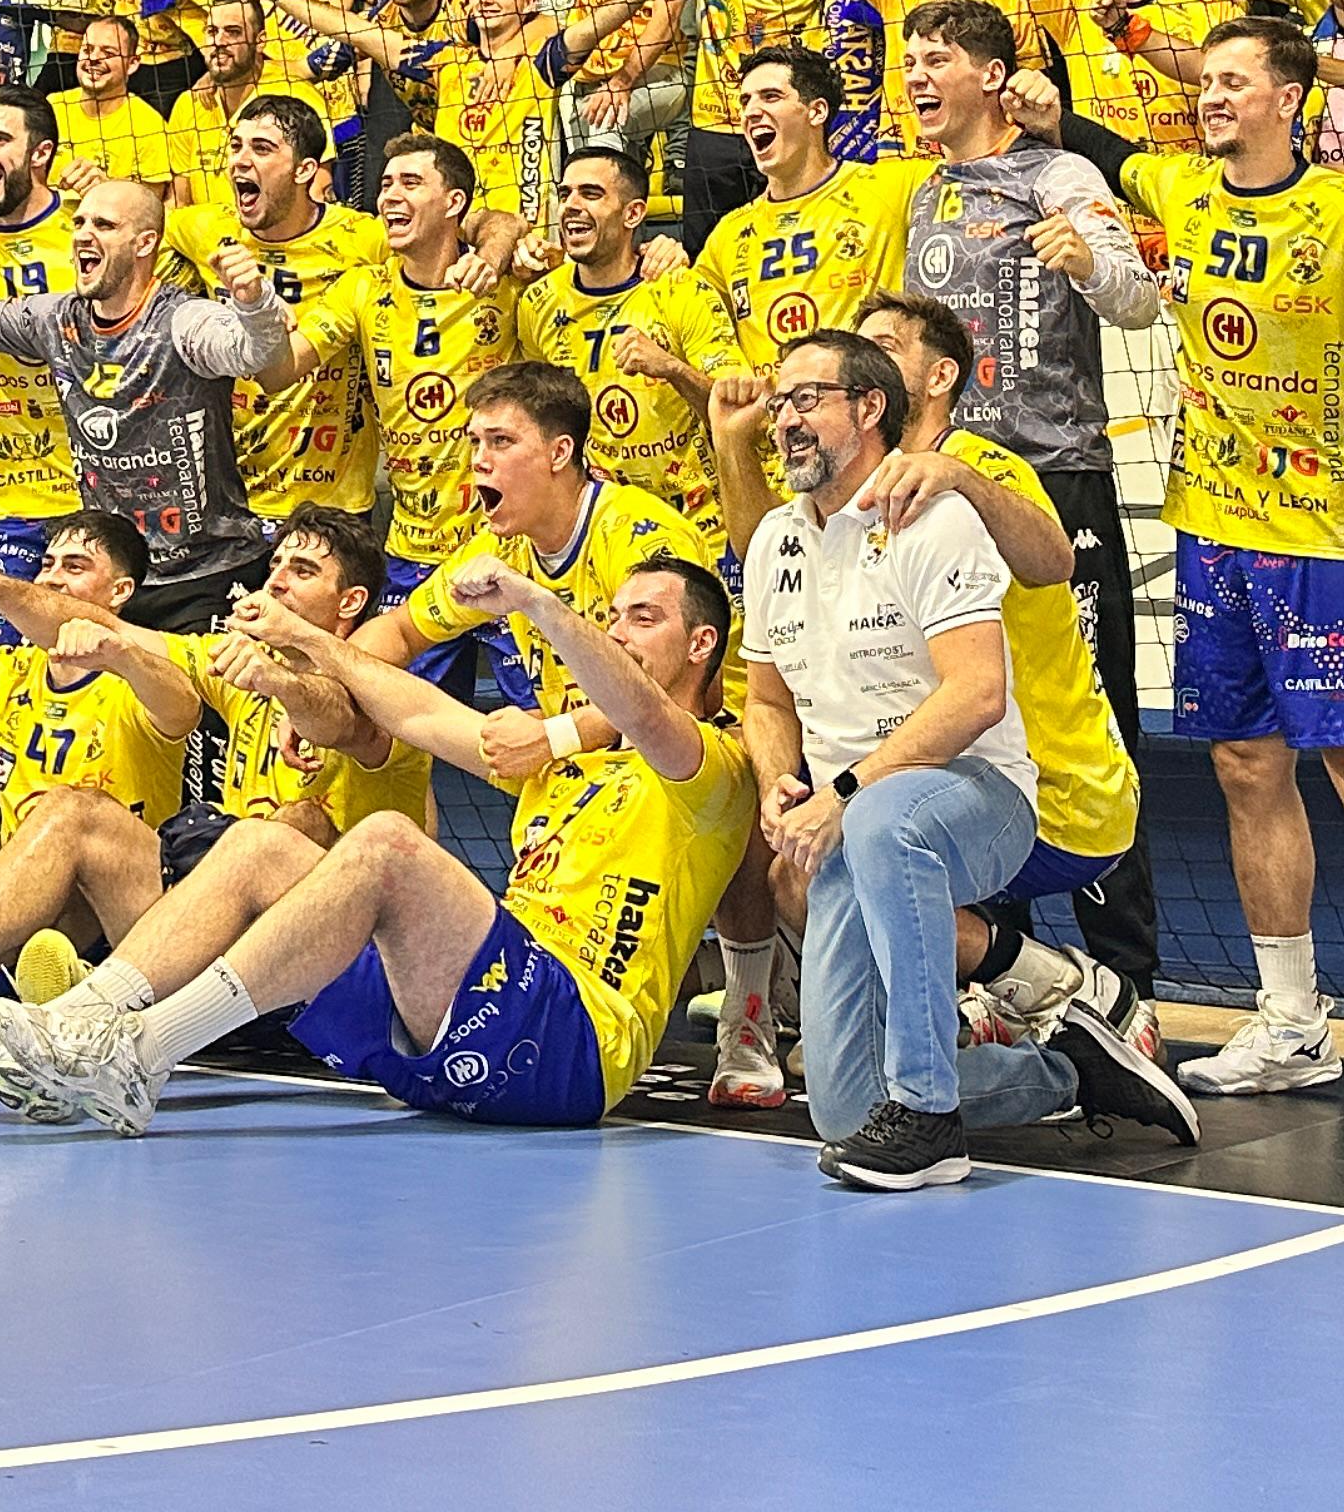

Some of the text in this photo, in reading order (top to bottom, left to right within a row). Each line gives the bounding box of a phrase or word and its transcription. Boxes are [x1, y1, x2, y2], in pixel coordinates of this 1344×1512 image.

[1089, 99, 1139, 123] tubos
[759, 230, 820, 282] 25
[1204, 228, 1268, 284] 50
[1018, 255, 1048, 371] haizea
[1272, 292, 1334, 315] GSK
[413, 317, 441, 358] 6
[997, 256, 1021, 393] tecnoaranda
[1221, 370, 1319, 395] aranda
[963, 401, 1002, 423] LEÓN
[102, 447, 174, 472] aranda
[620, 431, 689, 460] aranda
[25, 721, 76, 775] 47
